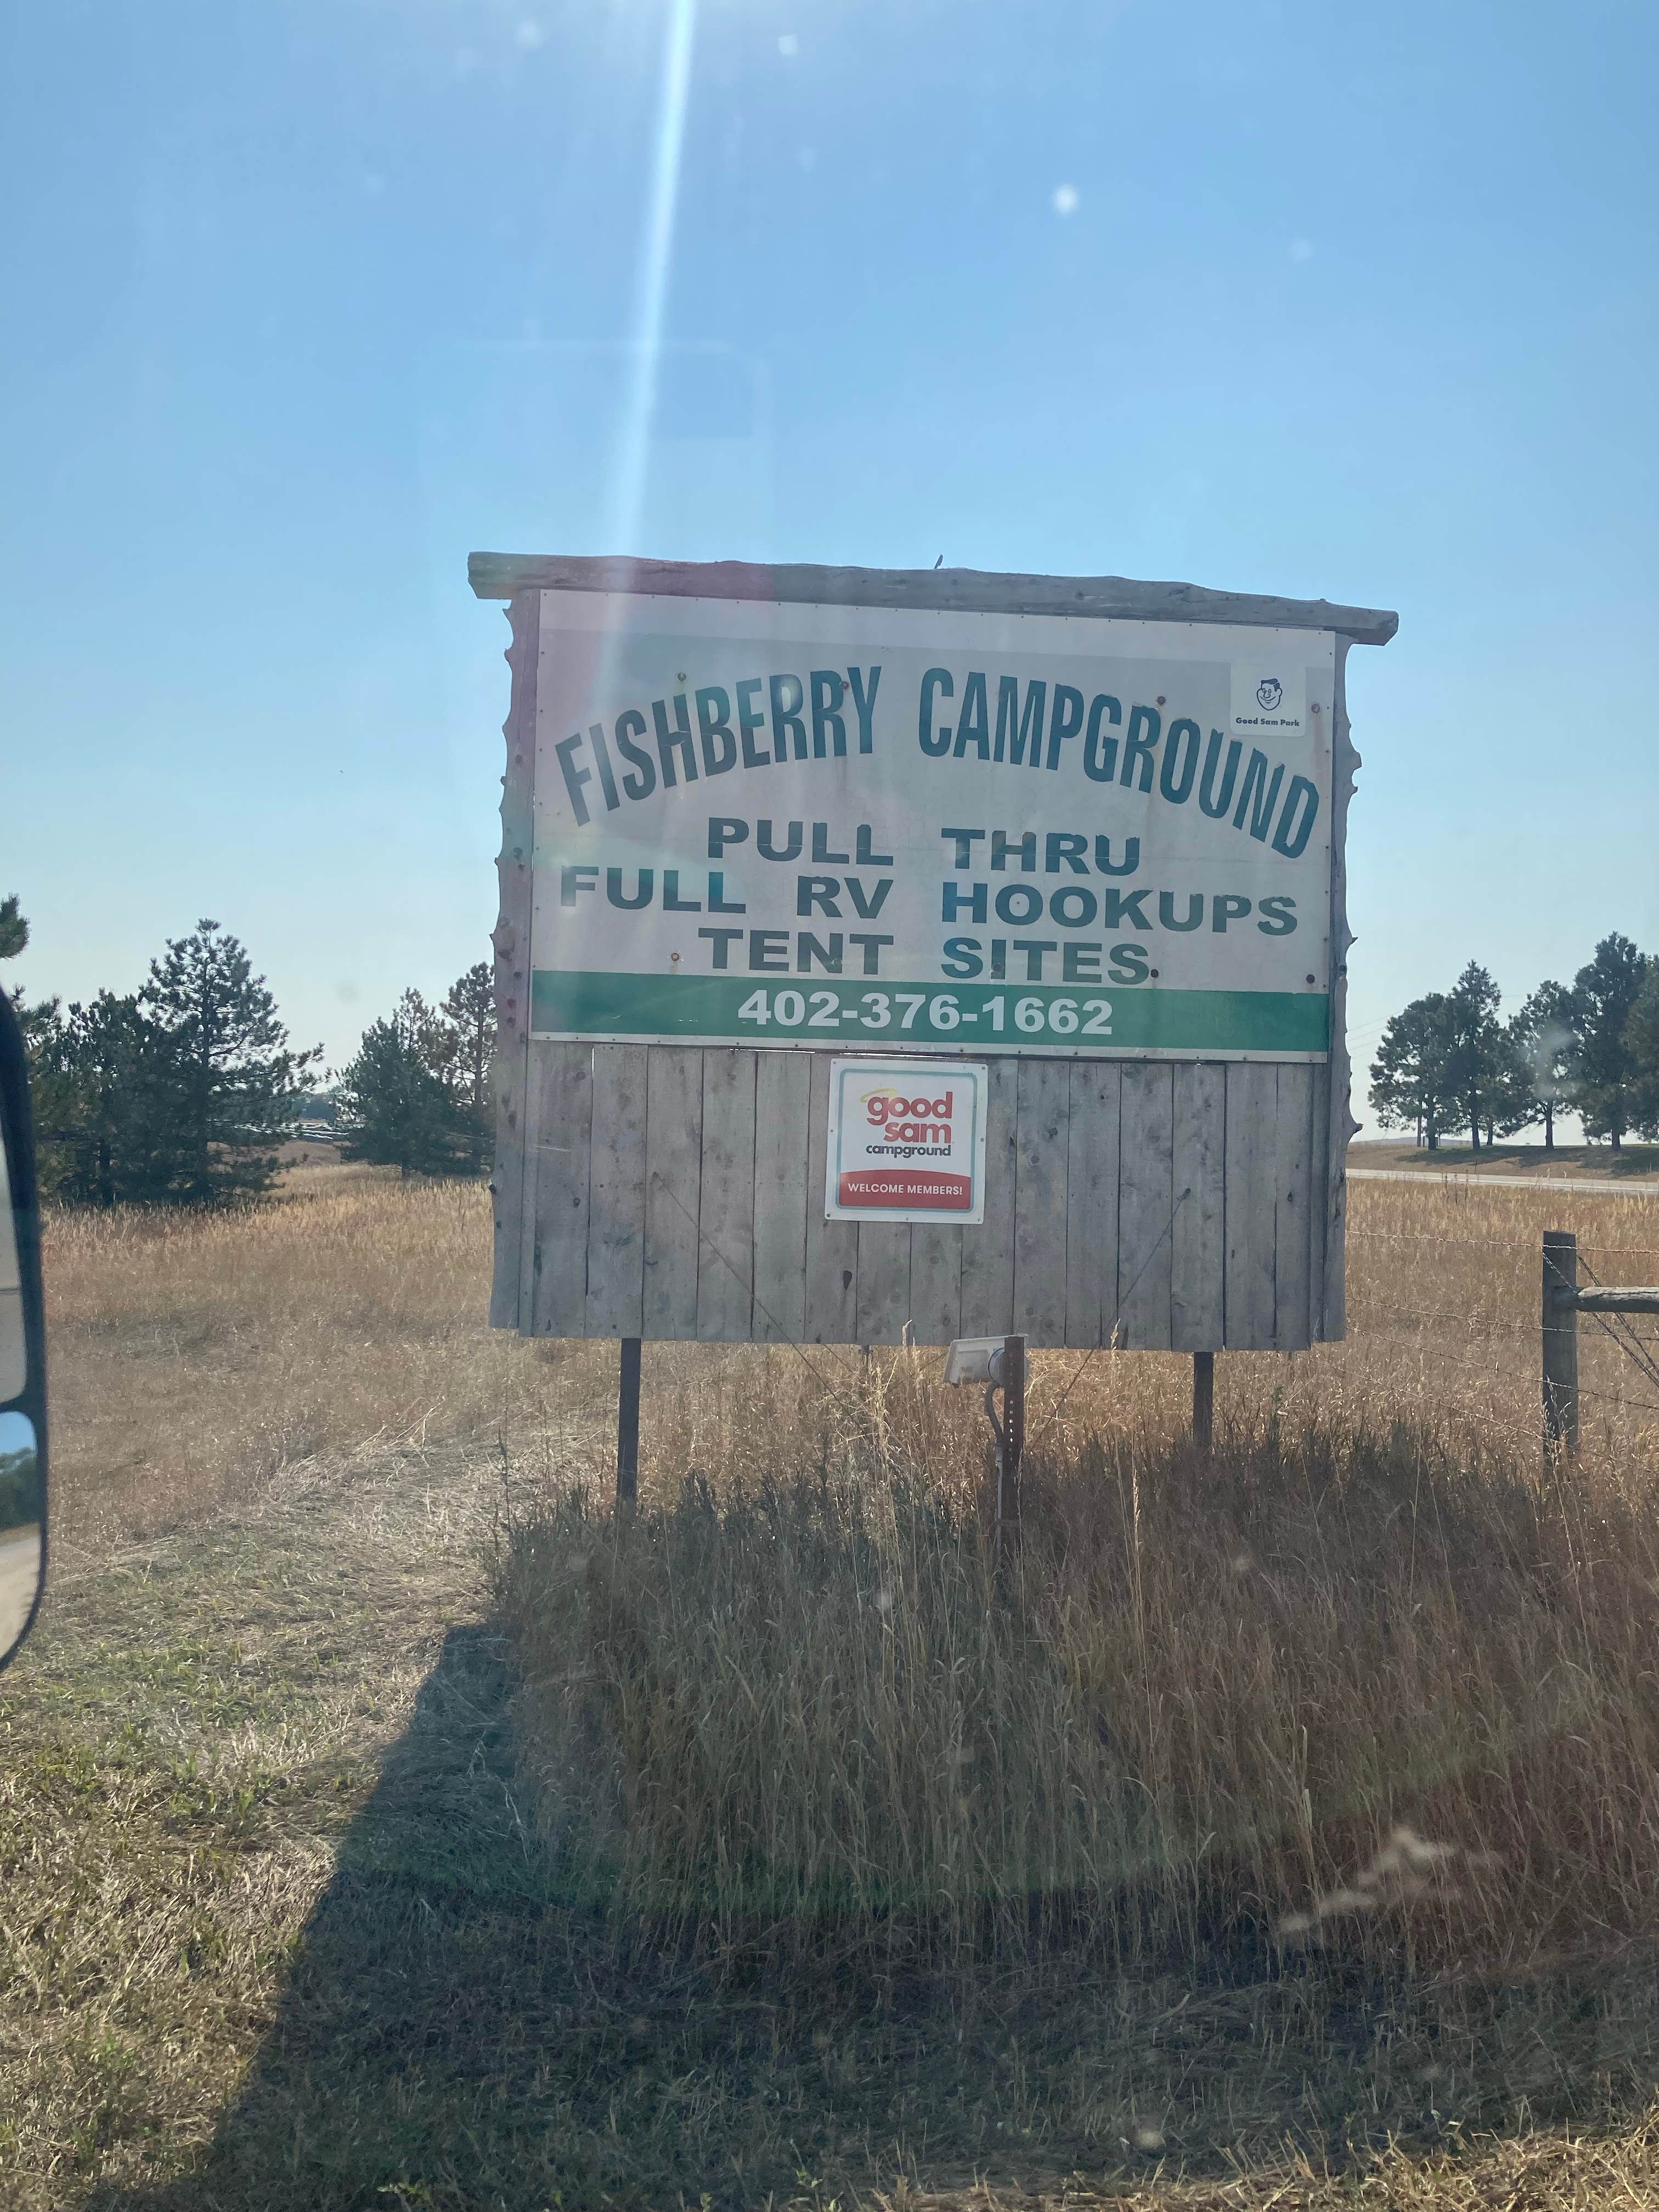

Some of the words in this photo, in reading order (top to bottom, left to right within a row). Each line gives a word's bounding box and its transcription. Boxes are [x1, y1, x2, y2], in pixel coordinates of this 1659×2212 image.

[555, 665, 882, 827] FISHBERRY
[918, 668, 1319, 859] CAMPGROUND
[708, 817, 894, 866] PULL
[941, 827, 1140, 876] THRU
[560, 866, 746, 914] FULL
[797, 875, 894, 919] RV
[941, 882, 1297, 936] HOOKUPS
[698, 928, 894, 975] TENT
[941, 937, 1149, 985] SITES
[738, 989, 1113, 1035] 402-376-1662
[866, 1091, 953, 1126] good
[866, 1144, 951, 1158] campground
[883, 1122, 951, 1144] sam
[848, 1183, 904, 1194] WELCOME
[907, 1186, 963, 1195] MEMBERS!
